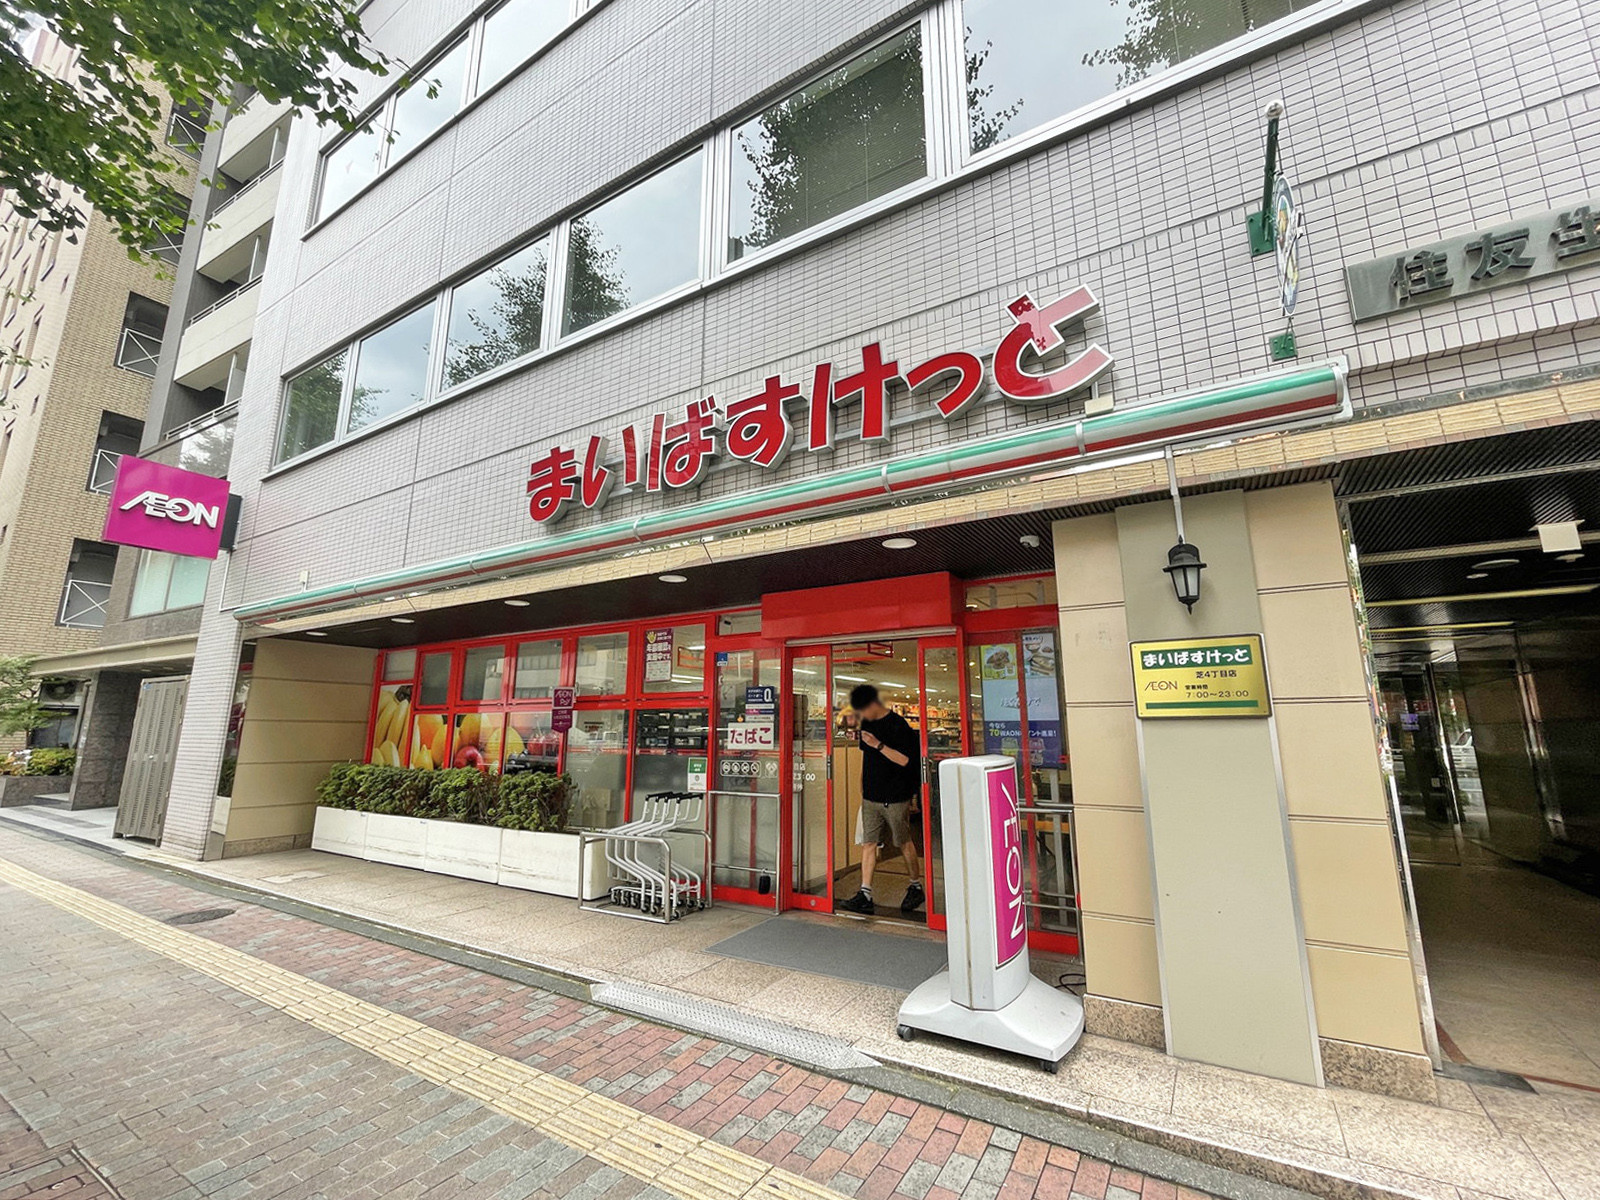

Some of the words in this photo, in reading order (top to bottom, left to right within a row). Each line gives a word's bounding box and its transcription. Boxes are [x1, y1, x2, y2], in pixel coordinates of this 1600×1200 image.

[526, 283, 1114, 525] まいばすけっと
[1143, 648, 1250, 667] まいばすけっと
[1195, 670, 1238, 679] 芝4丁目店
[730, 727, 772, 745] たばこ
